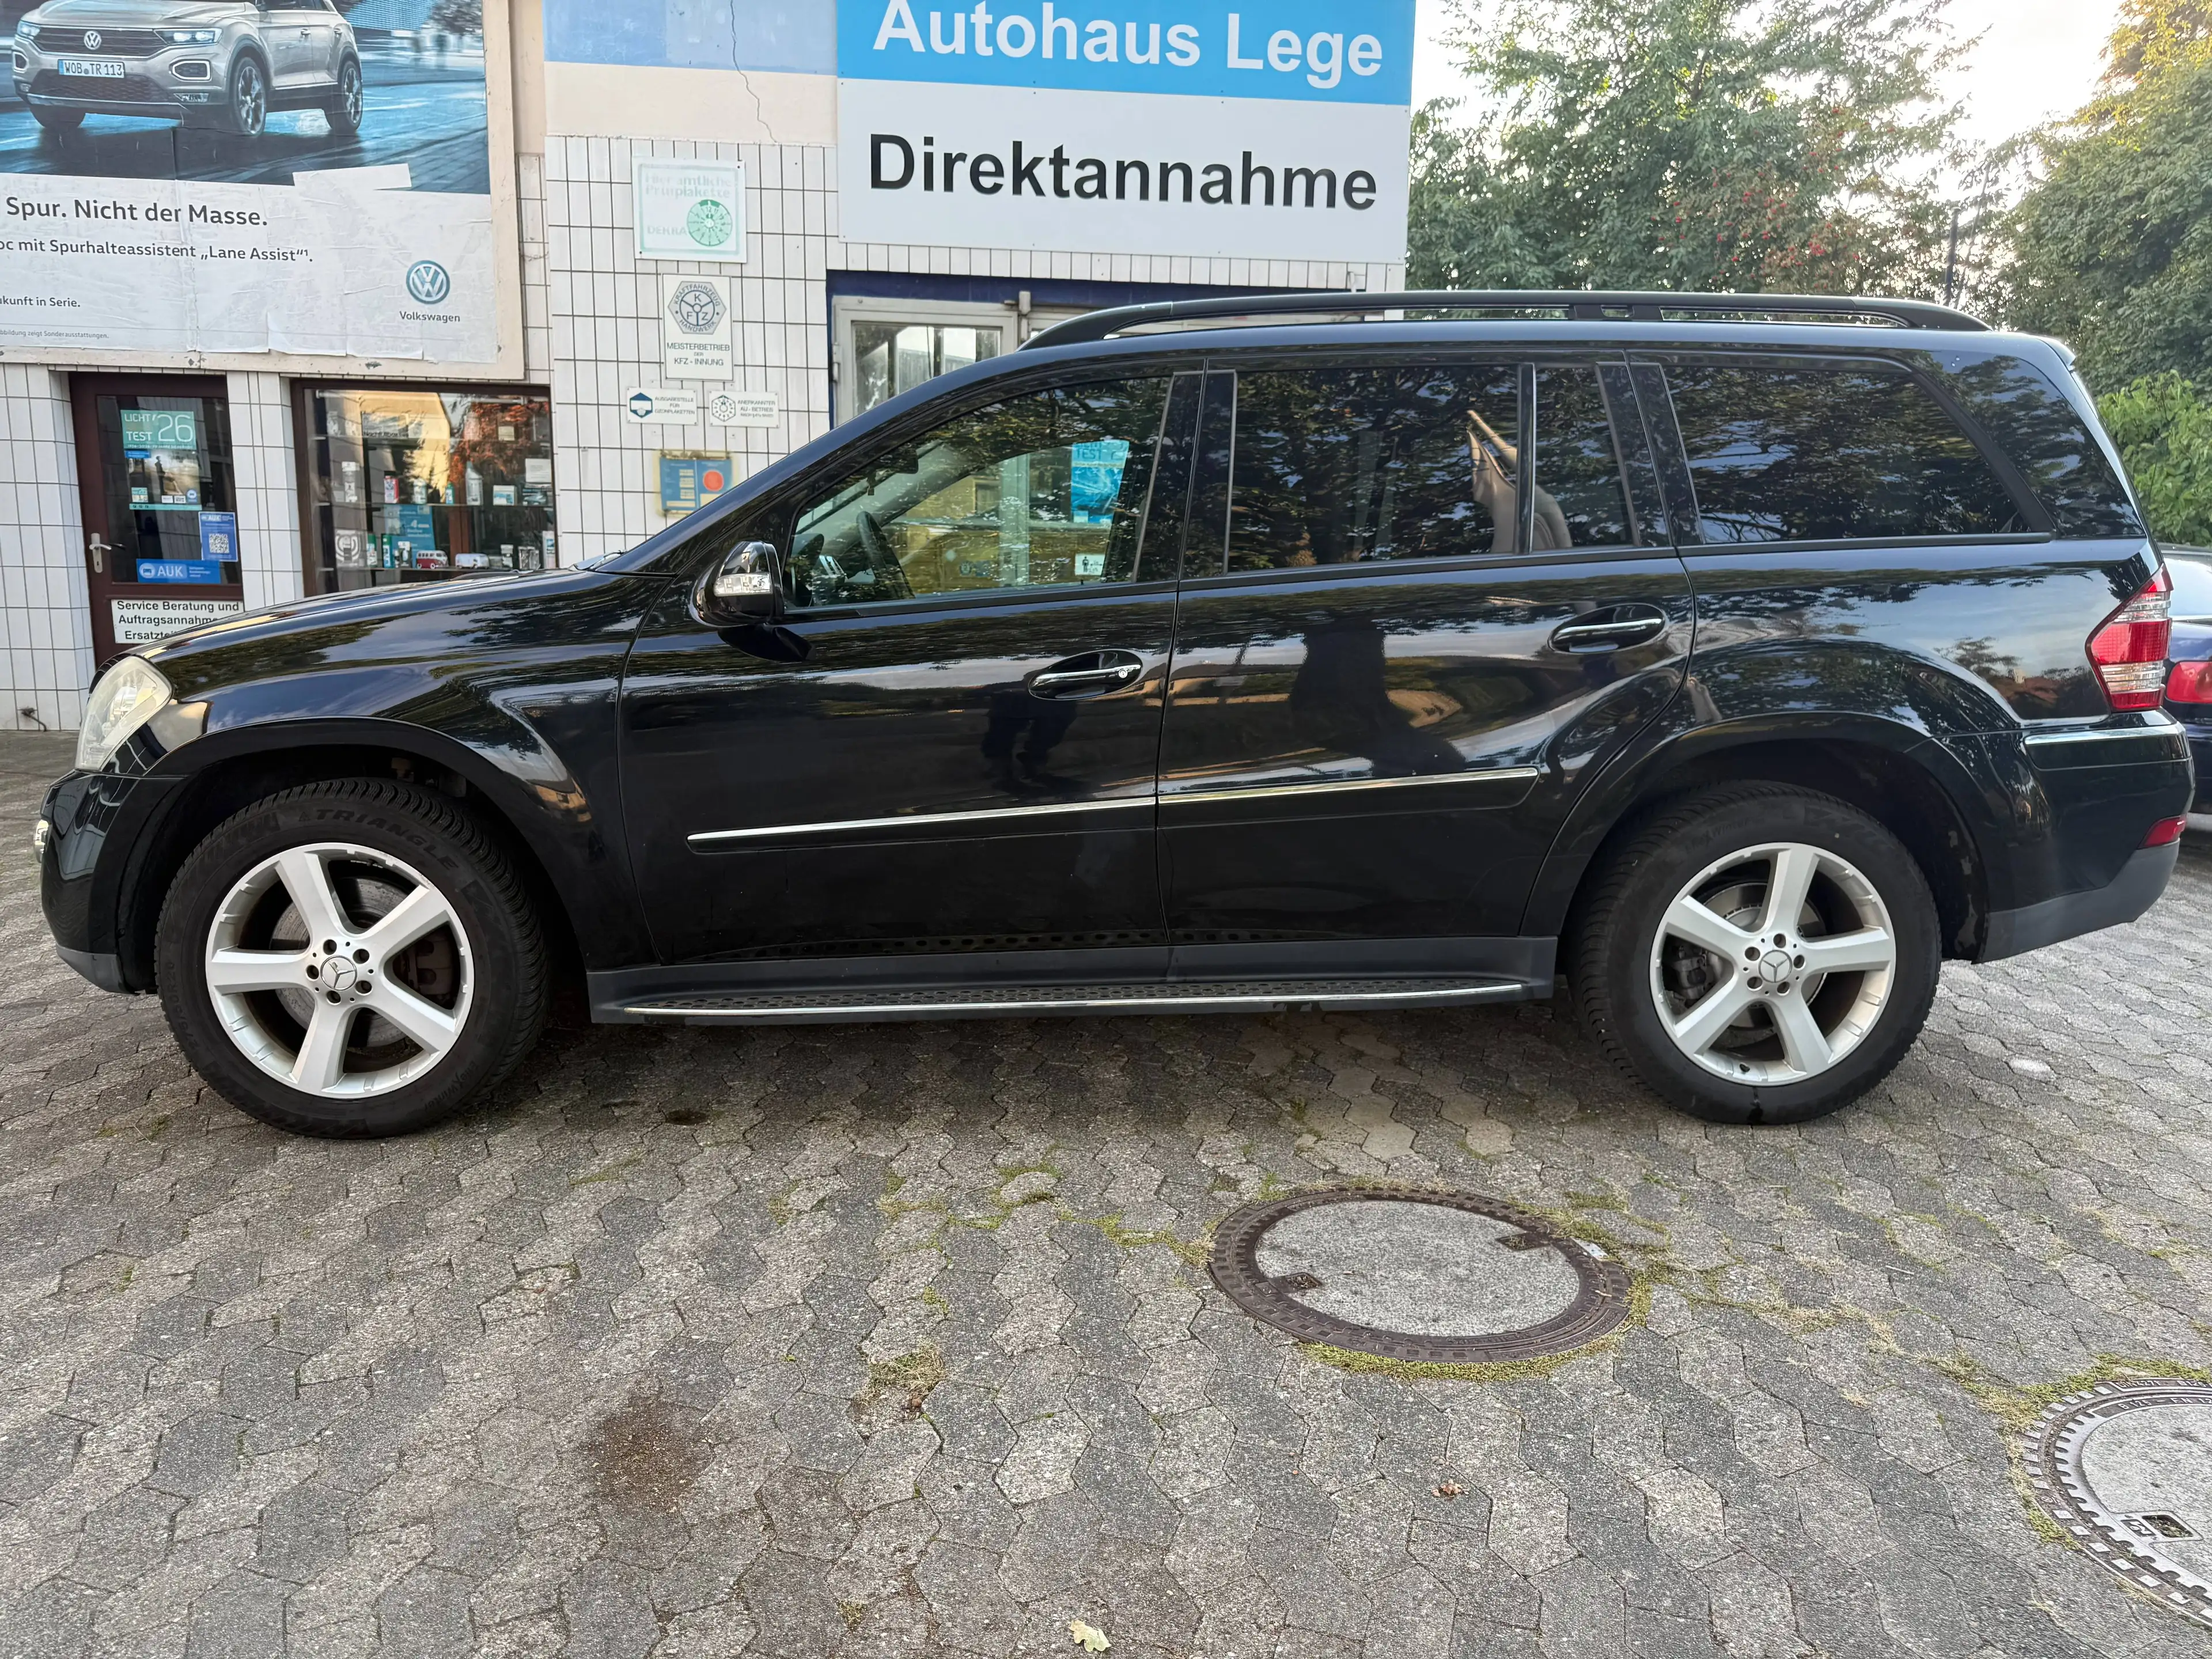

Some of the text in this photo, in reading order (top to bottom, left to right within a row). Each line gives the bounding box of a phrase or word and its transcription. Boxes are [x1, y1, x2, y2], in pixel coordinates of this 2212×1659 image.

[873, 0, 1383, 89] Autohaus Lege
[870, 133, 1377, 210] Direktannahme
[6, 196, 267, 226] Spur. Nicht der Masse.
[18, 238, 46, 252] mit
[50, 239, 196, 257] Spurhalteassistent
[673, 283, 721, 306] KRAFTFAHRZEUG
[36, 296, 47, 306] in
[50, 297, 81, 308] Serie.
[399, 310, 460, 324] Volkswagen
[679, 319, 717, 332] HANDWERK
[44, 330, 109, 339] Sonderausstattungen.
[667, 342, 730, 352] MEISTERBETRIEB
[124, 414, 150, 422] LICHT
[126, 431, 153, 441] TEST
[1076, 449, 1101, 460] TEST
[157, 566, 183, 577] AUK
[117, 600, 239, 613] Service Beratung und
[315, 809, 460, 871] TRIANGLE
